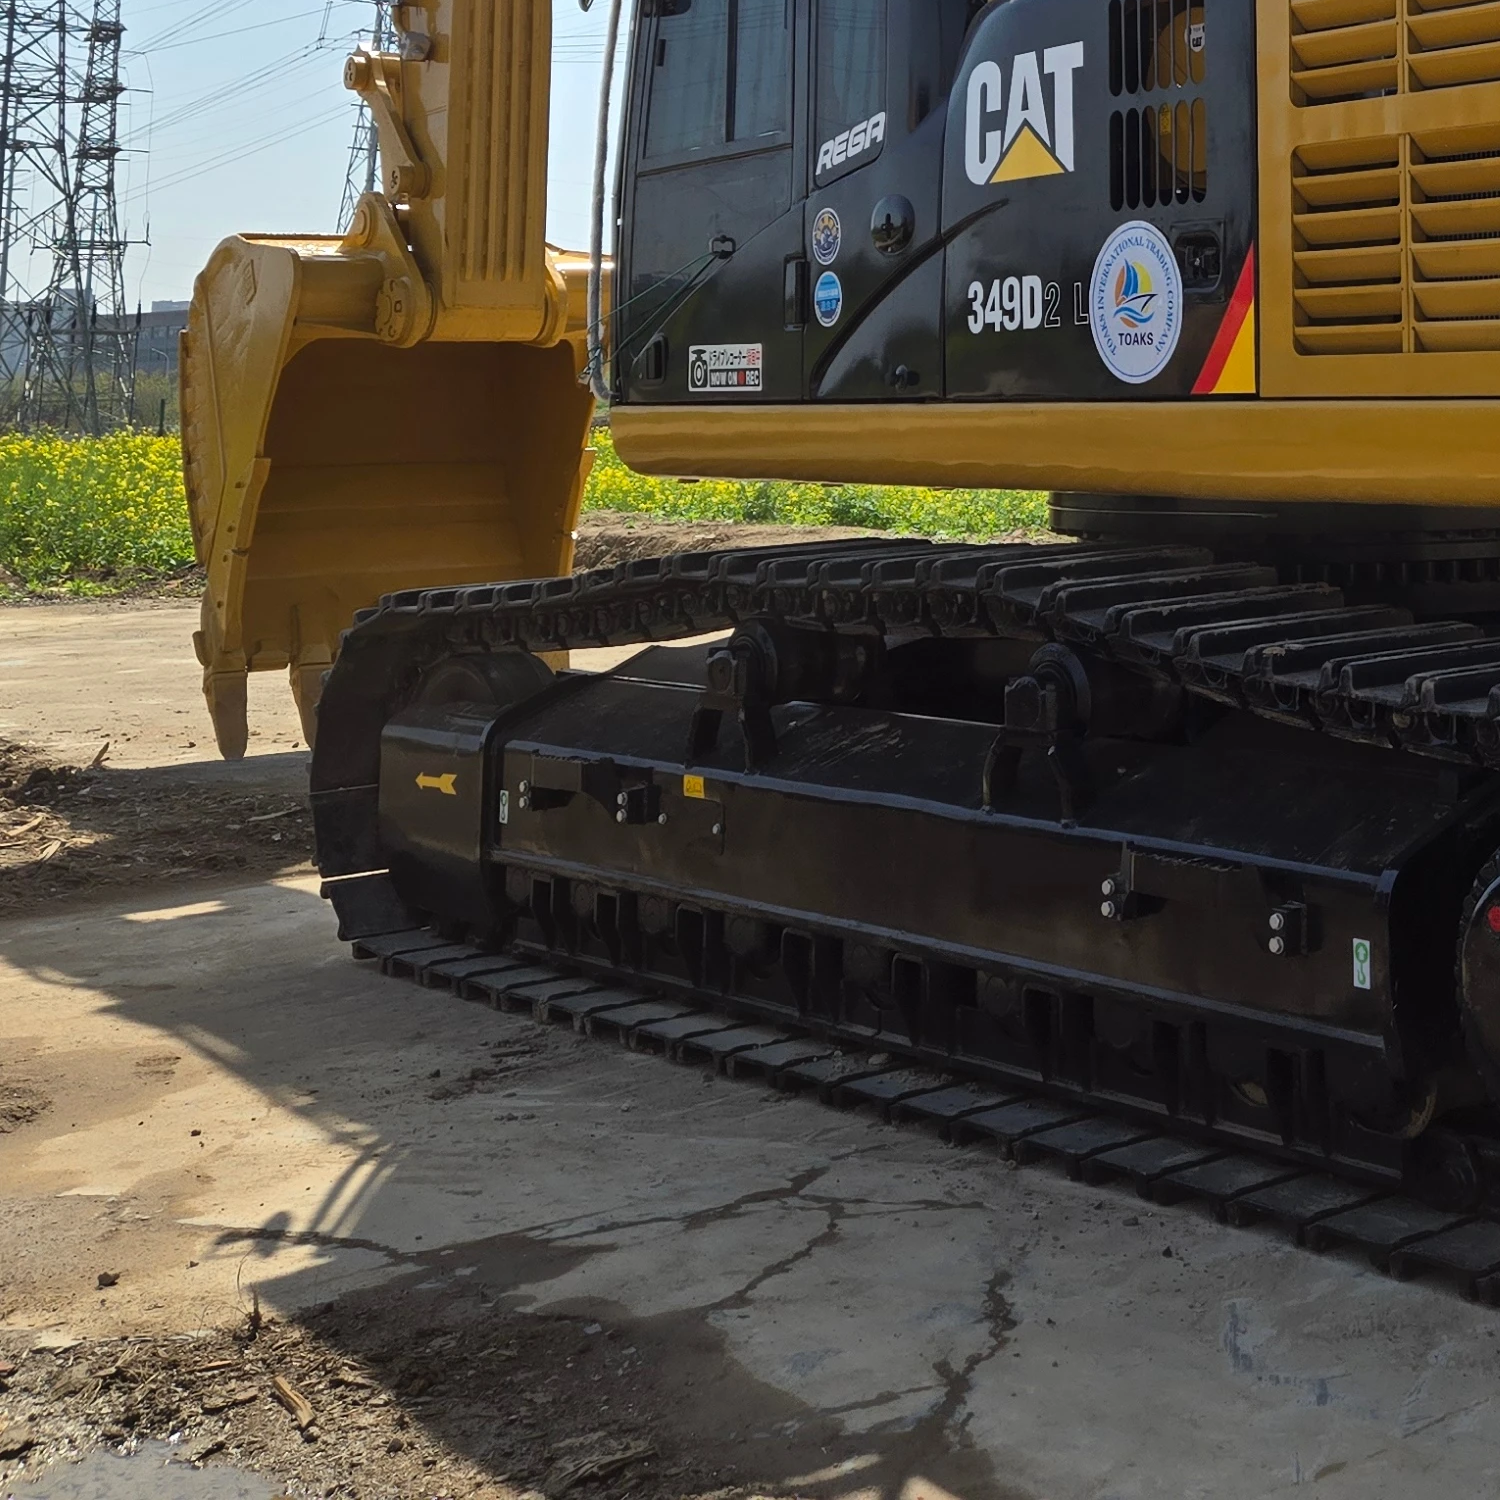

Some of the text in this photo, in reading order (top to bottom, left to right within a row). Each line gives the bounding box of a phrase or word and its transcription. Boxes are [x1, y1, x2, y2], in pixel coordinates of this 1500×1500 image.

[964, 40, 1084, 186] CAT
[815, 111, 886, 176] REGA
[1073, 282, 1089, 325] L
[1097, 235, 1174, 356] TOAKS INTERNATIONAL TRADING COMPANY
[1118, 332, 1154, 346] TOAKS
[710, 369, 759, 386] NOW ON REC
